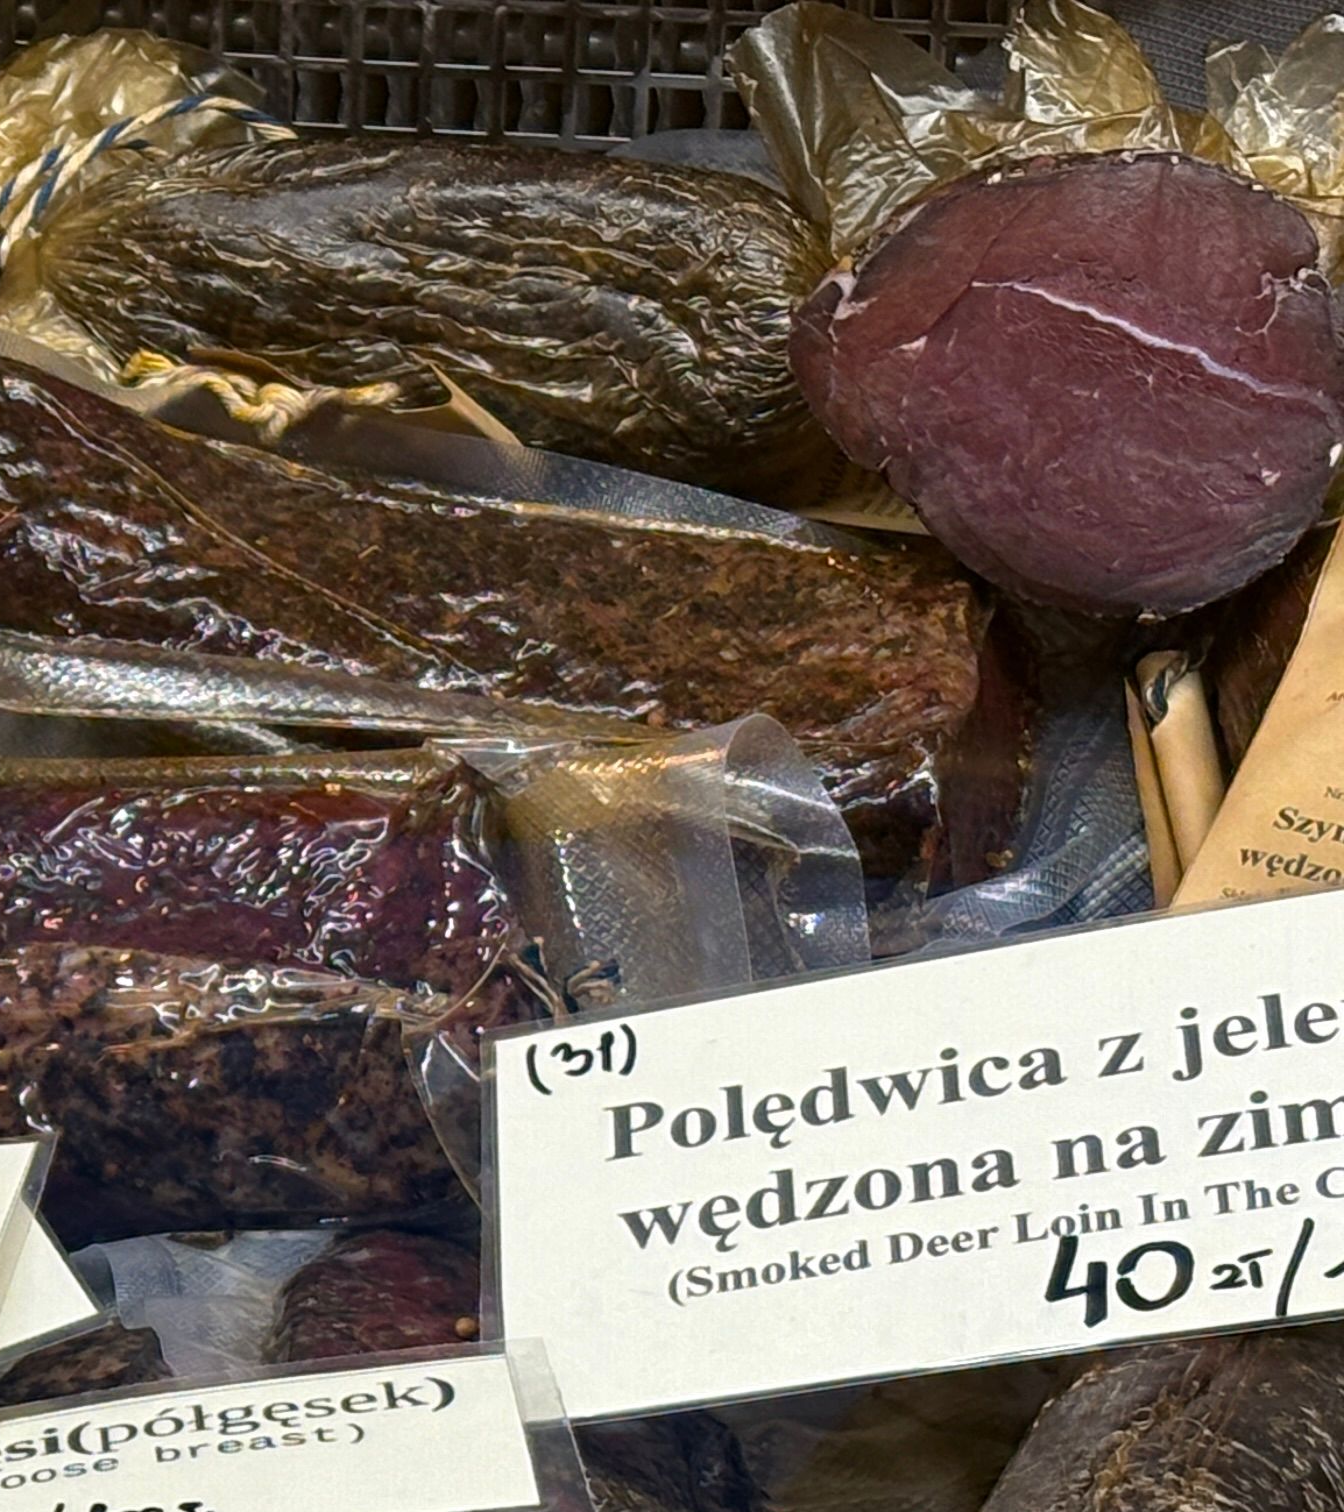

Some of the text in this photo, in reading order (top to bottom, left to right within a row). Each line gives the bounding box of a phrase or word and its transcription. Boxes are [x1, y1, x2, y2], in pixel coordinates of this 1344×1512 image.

[527, 1024, 636, 1095] (31)
[605, 994, 1343, 1160] Polędwica z jele
[619, 1150, 1020, 1252] wędzona
[1052, 1126, 1166, 1179] na
[669, 1240, 871, 1306] (Smoked
[888, 1227, 999, 1264] Deer
[1015, 1204, 1122, 1243] Loin
[1140, 1194, 1190, 1225] In
[1205, 1180, 1299, 1214] The
[1045, 1217, 1194, 1328] 40
[155, 1424, 364, 1462] breast)
